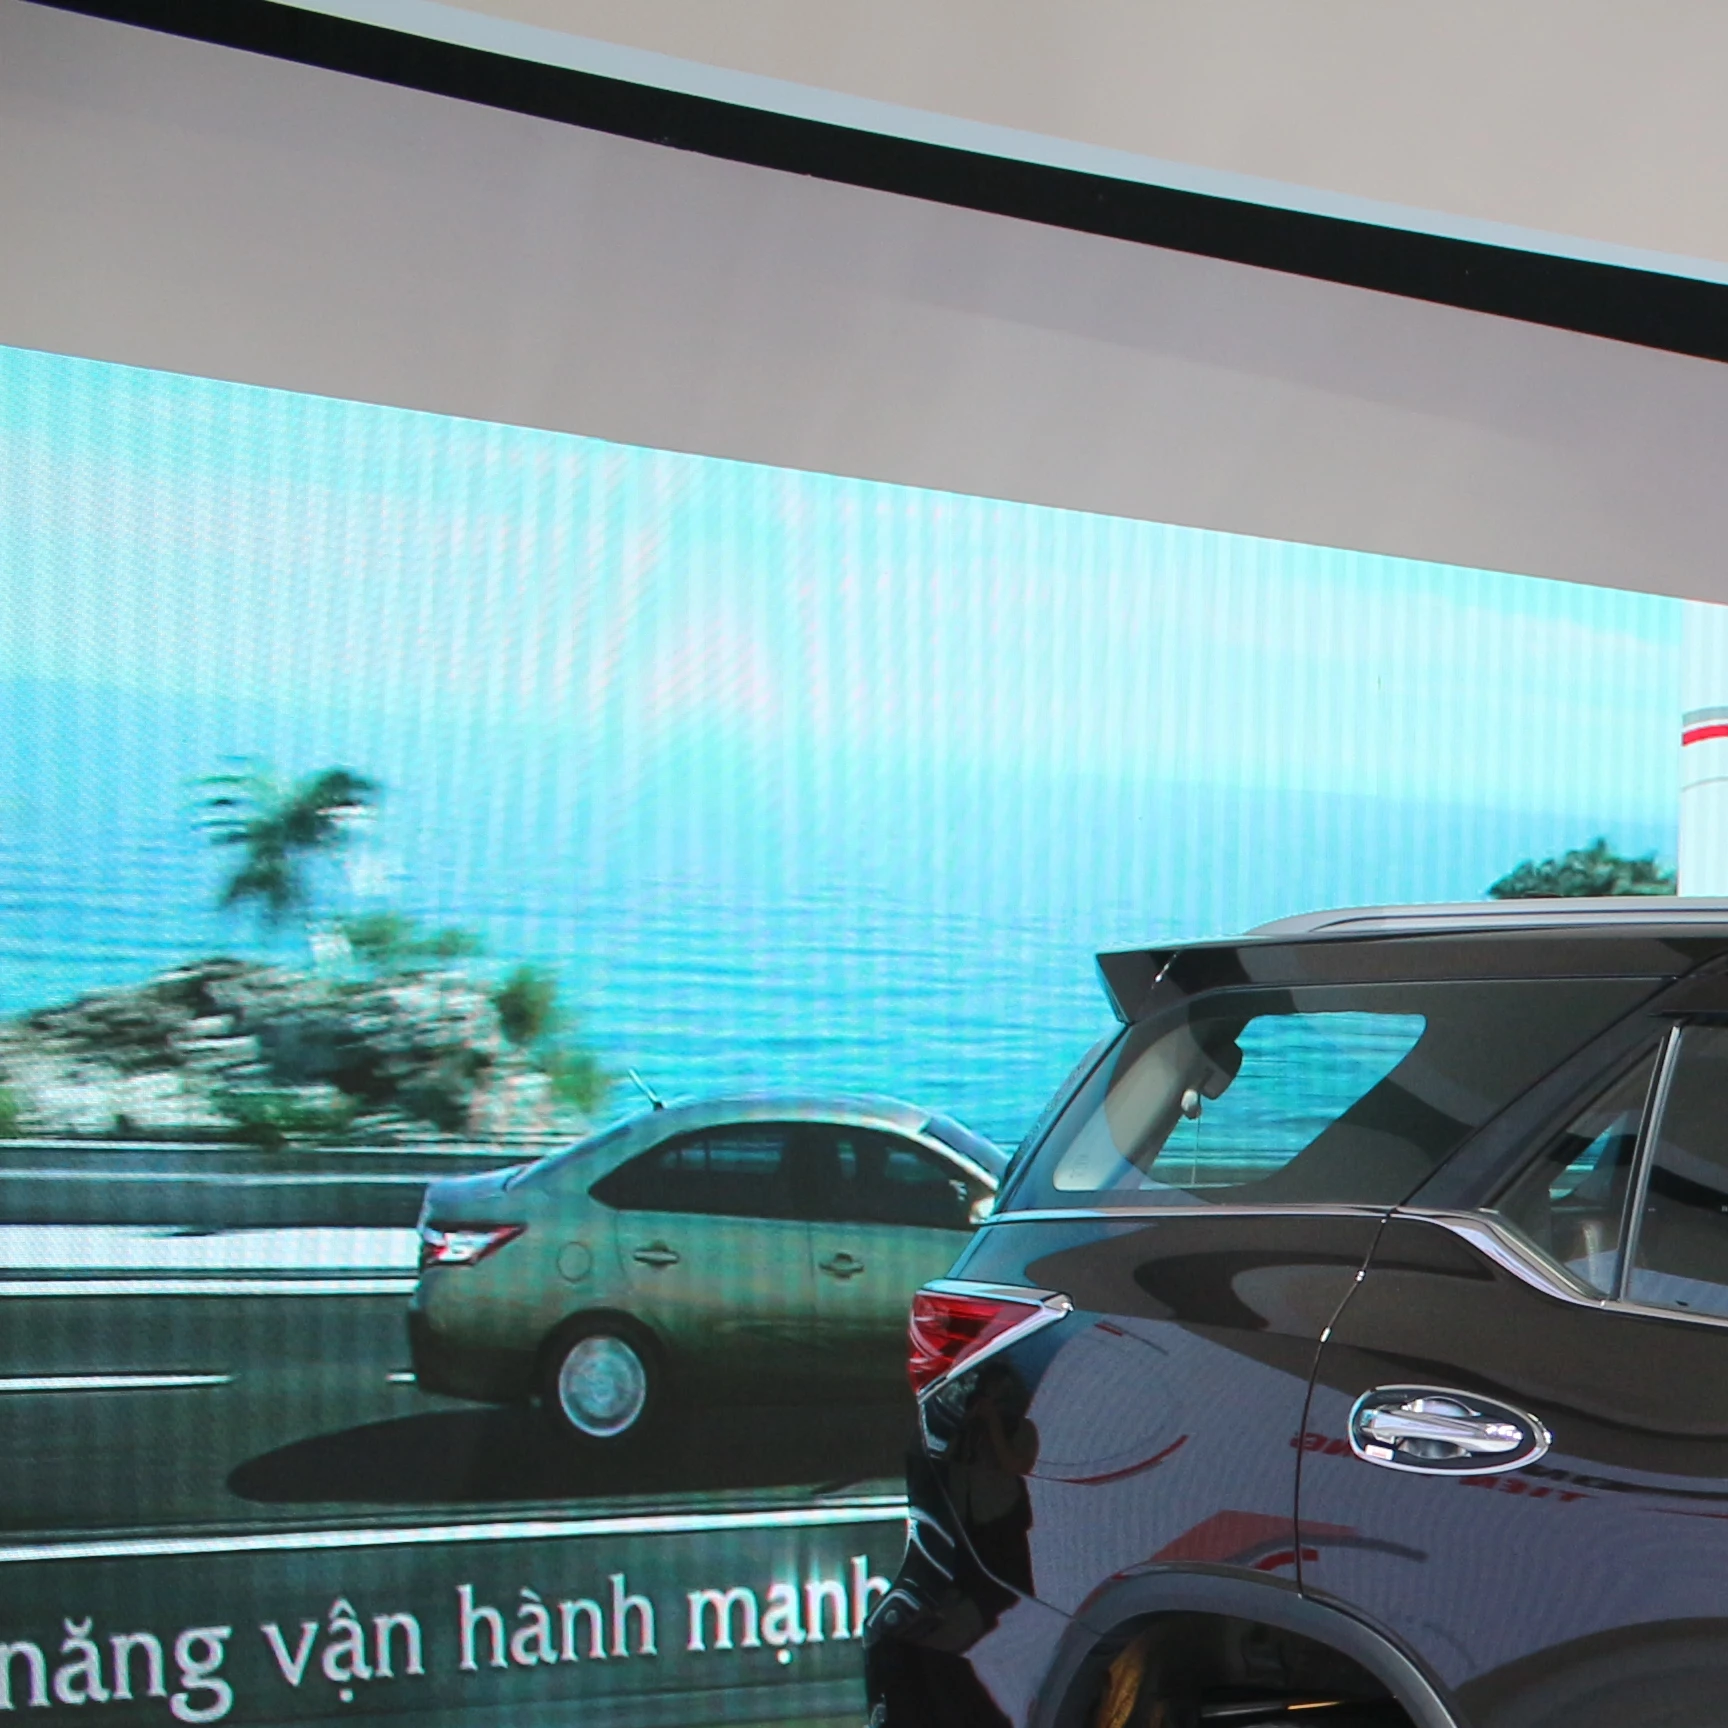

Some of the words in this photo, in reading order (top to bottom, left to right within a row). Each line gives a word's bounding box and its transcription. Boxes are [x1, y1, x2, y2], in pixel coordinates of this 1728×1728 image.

[260, 1596, 425, 1703] vận
[456, 1573, 657, 1670] hành
[687, 1554, 892, 1666] mạnh
